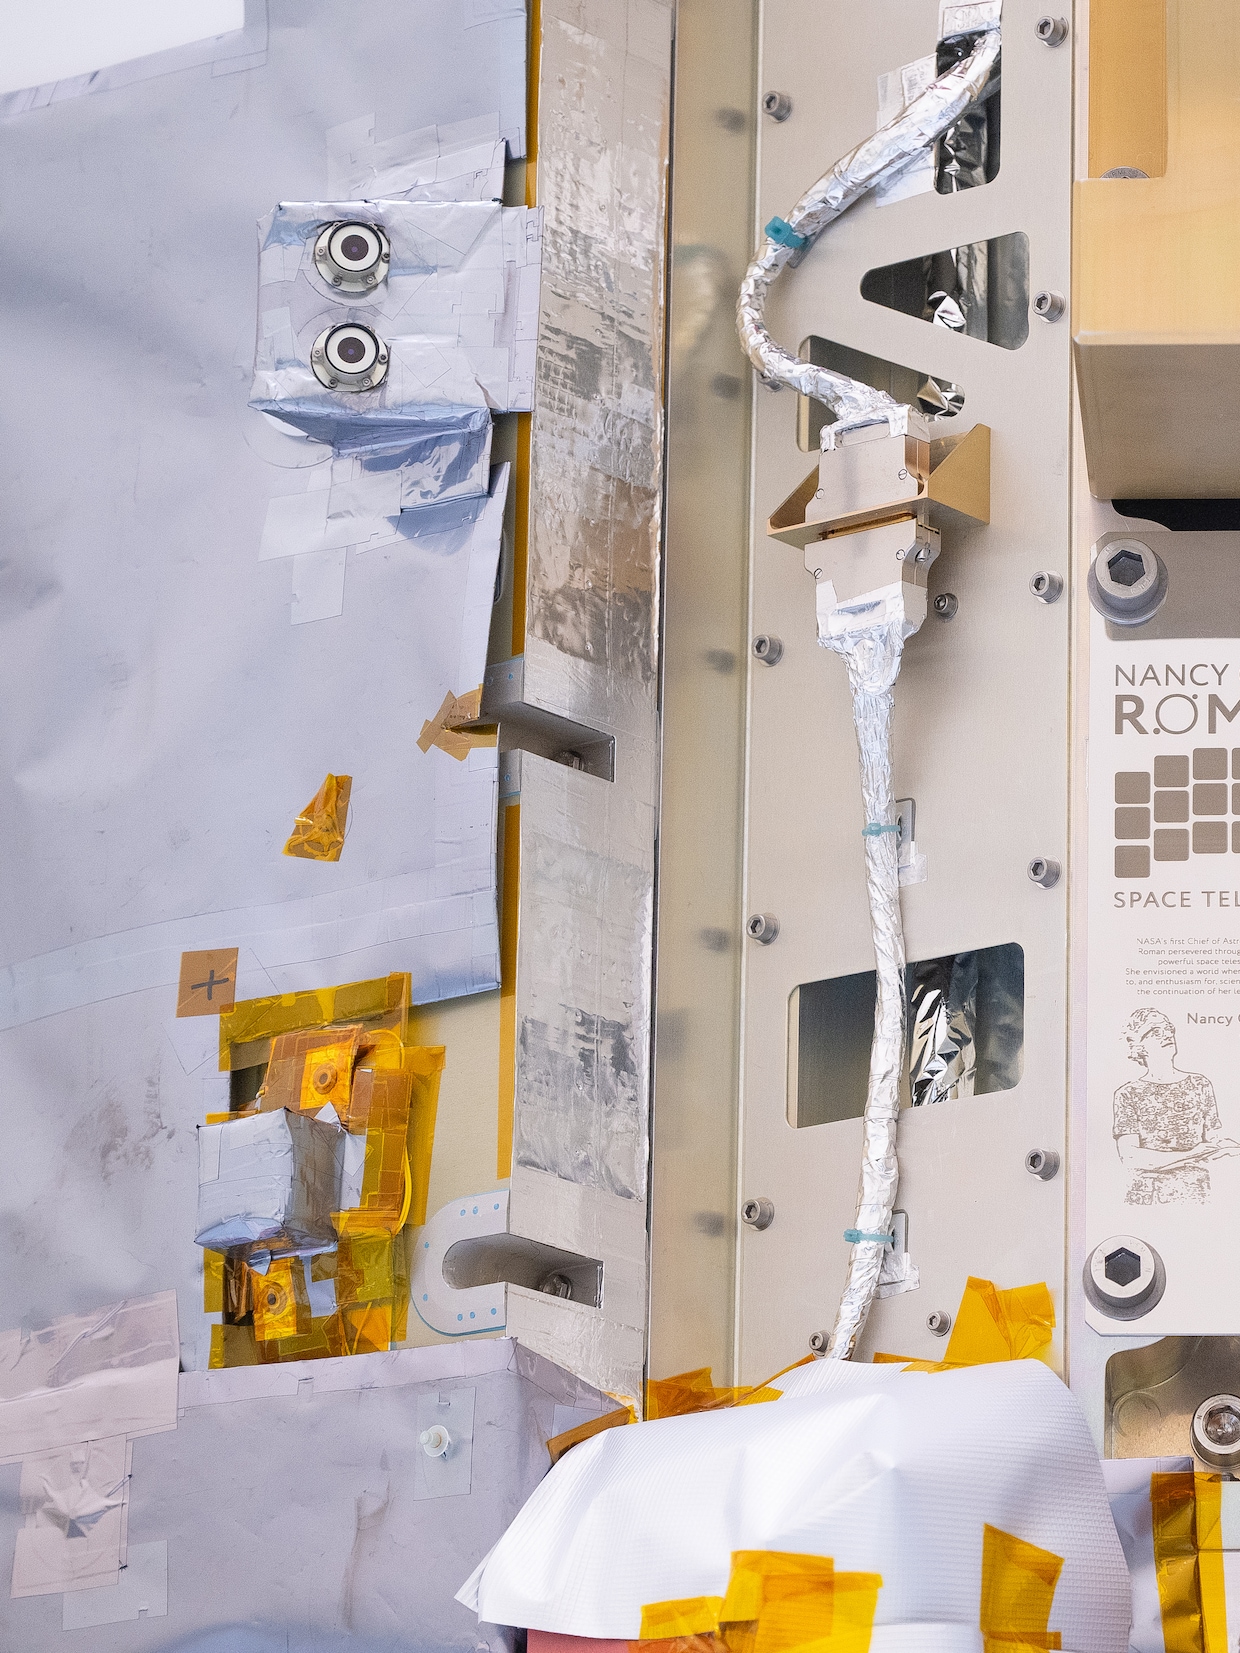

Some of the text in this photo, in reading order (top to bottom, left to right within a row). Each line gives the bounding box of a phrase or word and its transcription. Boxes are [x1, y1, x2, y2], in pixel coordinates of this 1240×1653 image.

[1114, 663, 1229, 687] NANCY
[1113, 891, 1192, 909] SPACE
[1136, 937, 1168, 945] NASA's
[1169, 937, 1185, 945] first
[1187, 937, 1210, 945] Chief
[1211, 937, 1220, 945] of
[1138, 947, 1166, 955] Roman
[1168, 948, 1213, 956] persevered
[1157, 957, 1194, 966] powerful
[1125, 967, 1141, 976] She
[1204, 977, 1218, 985] for,
[1207, 987, 1216, 995] of
[1218, 987, 1232, 995] her
[1187, 1012, 1233, 1027] Nancy
